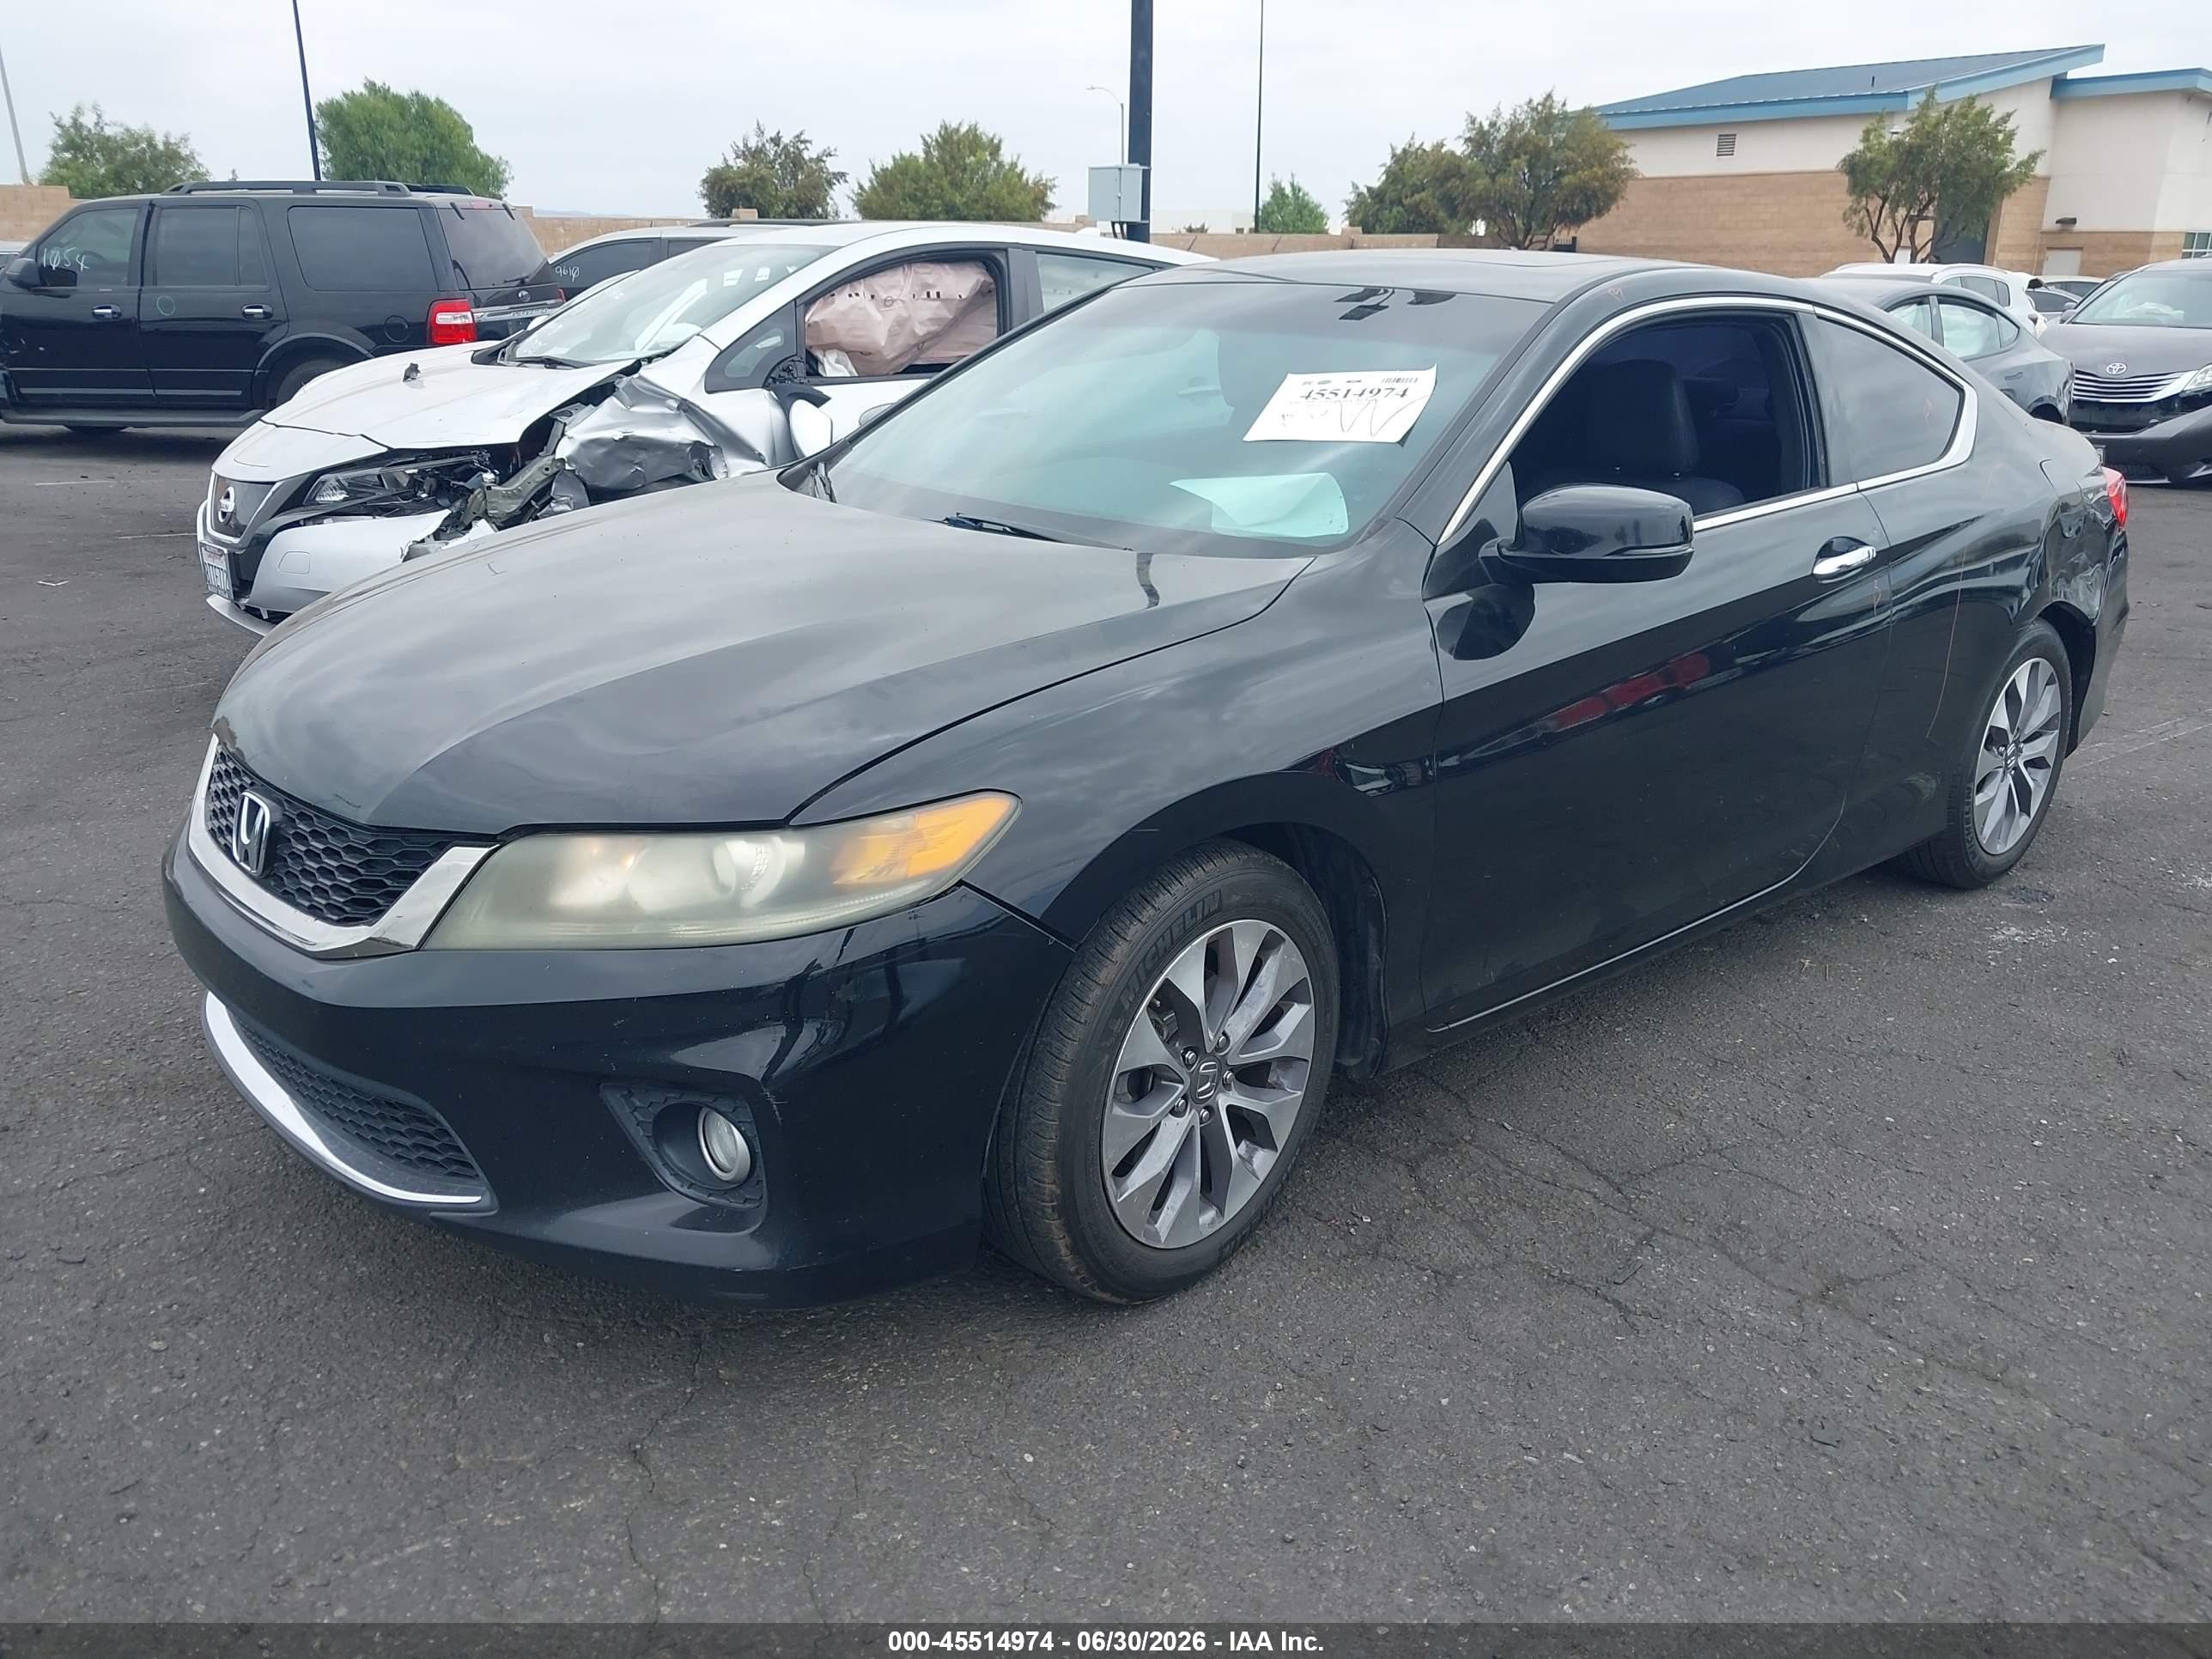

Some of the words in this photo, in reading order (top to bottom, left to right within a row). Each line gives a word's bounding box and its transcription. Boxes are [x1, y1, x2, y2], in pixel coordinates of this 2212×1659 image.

[43, 247, 90, 271] 1054
[555, 266, 580, 282] 9610
[1300, 387, 1409, 400] 45514974
[1119, 889, 1222, 1012] MICHELIN
